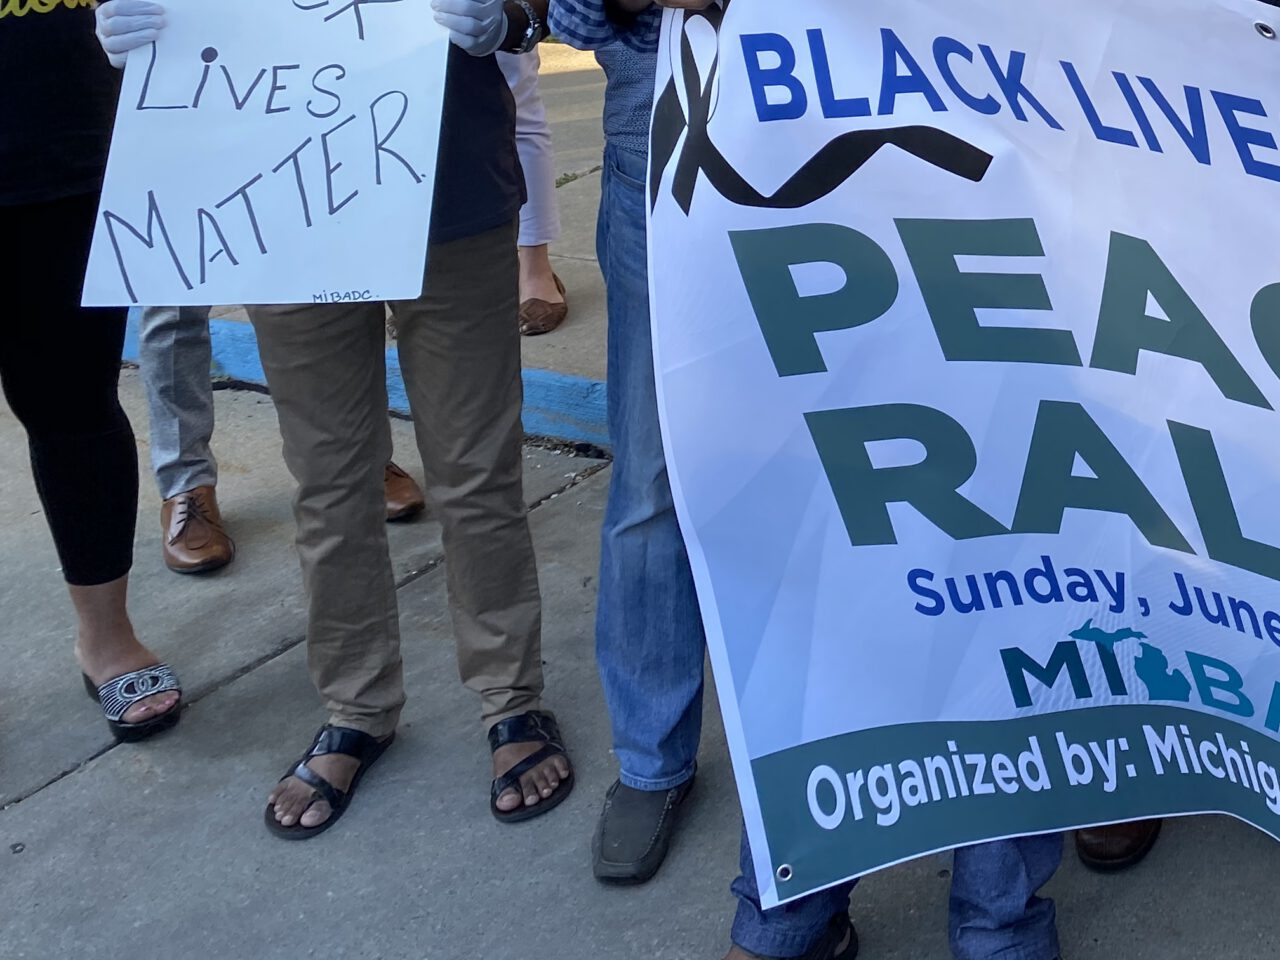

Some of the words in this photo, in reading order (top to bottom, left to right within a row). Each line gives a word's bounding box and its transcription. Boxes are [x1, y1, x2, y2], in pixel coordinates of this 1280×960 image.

[739, 28, 1065, 131] BLACK
[907, 555, 1151, 618] Sunday,
[806, 734, 1053, 831] Organized
[1055, 730, 1137, 794] by:
